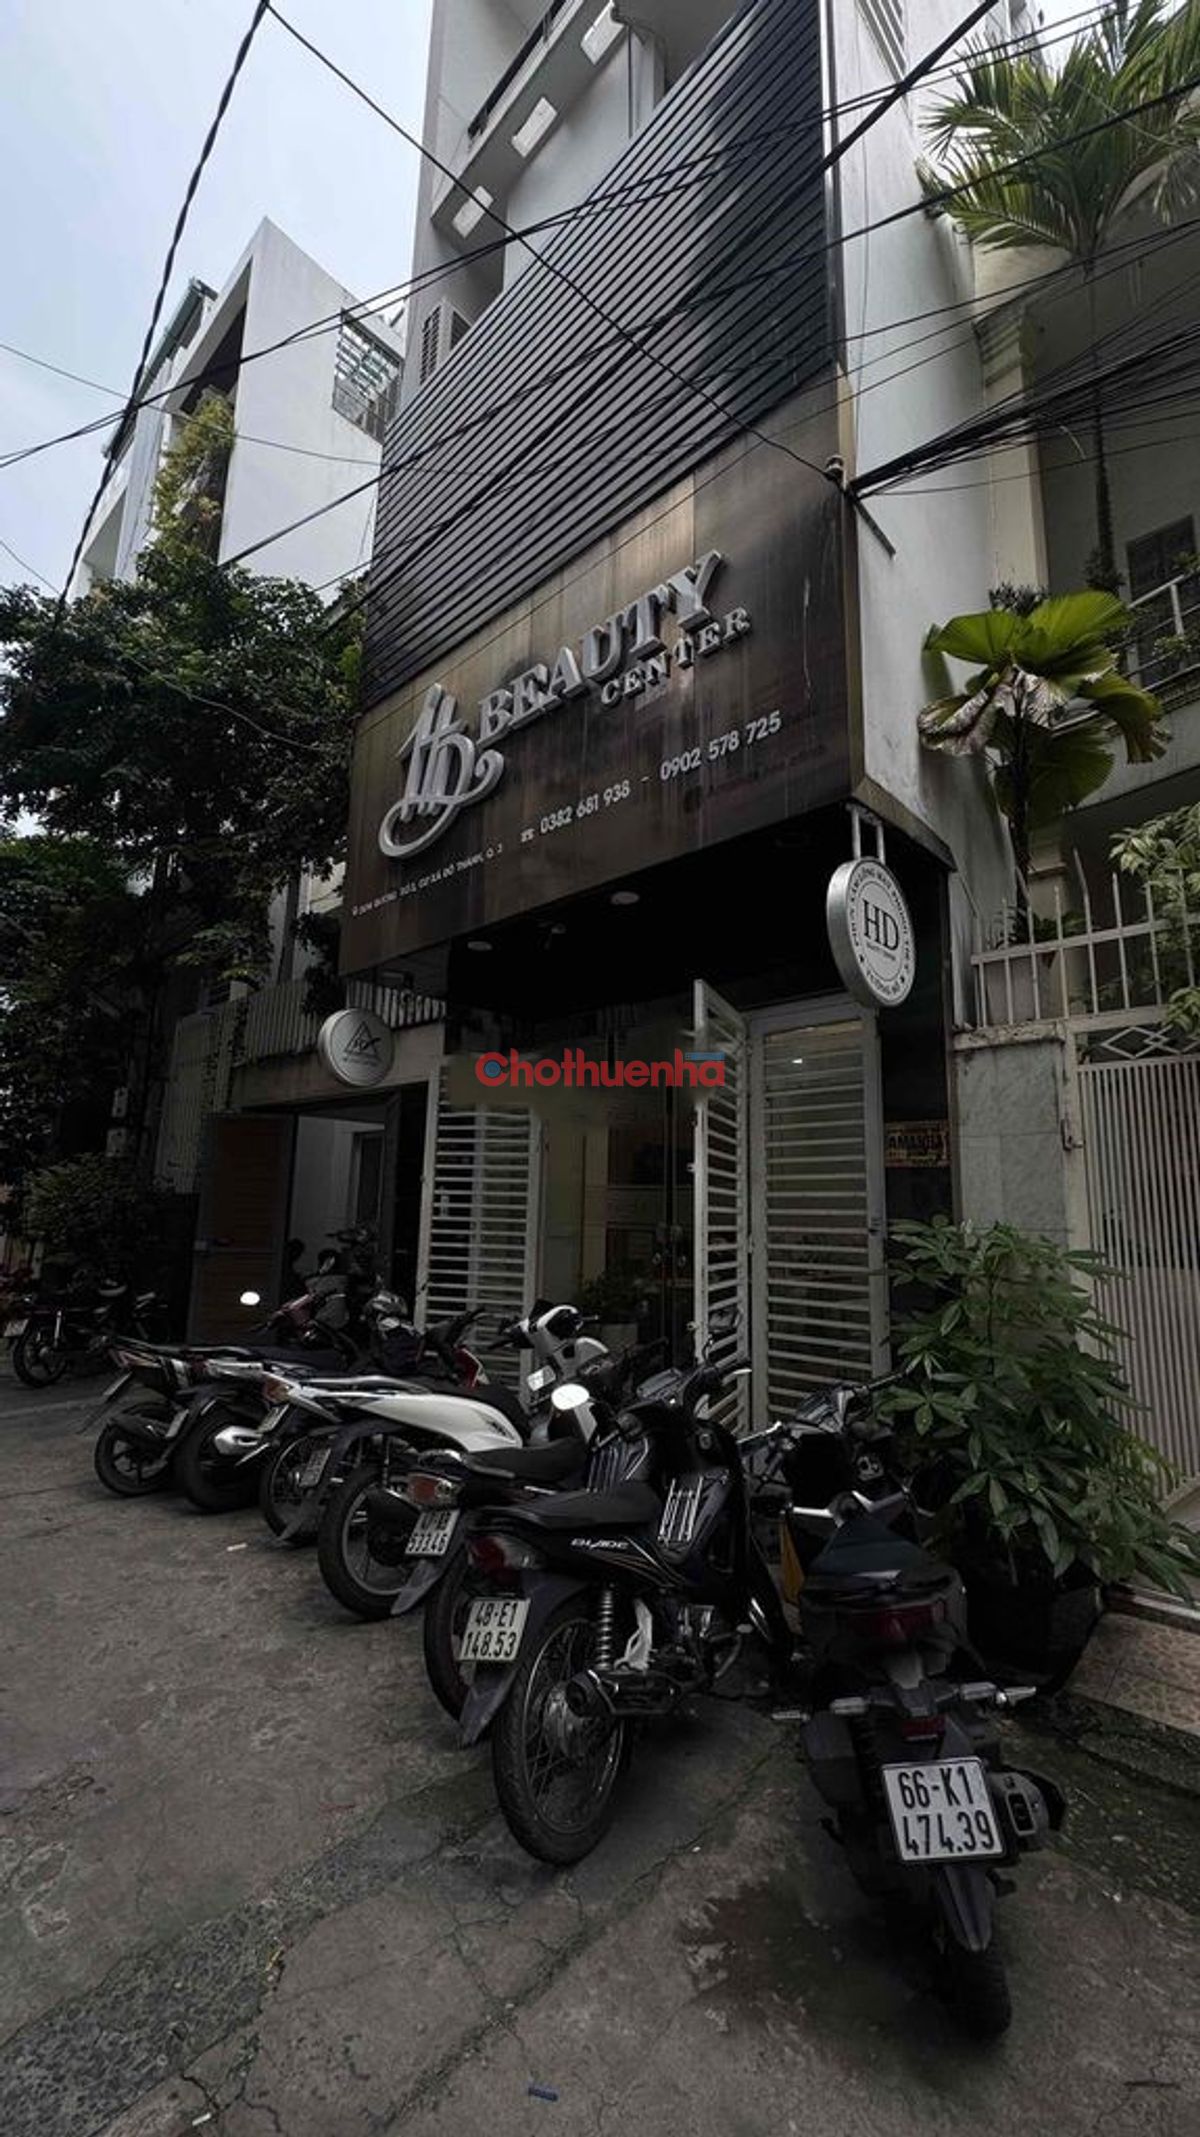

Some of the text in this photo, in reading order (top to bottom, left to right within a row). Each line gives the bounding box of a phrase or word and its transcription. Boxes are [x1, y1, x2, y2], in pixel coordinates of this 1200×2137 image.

[475, 549, 725, 746] BEAUTY
[601, 607, 751, 704] CENTER
[540, 805, 573, 834] 0382
[576, 793, 599, 818] 681
[603, 780, 631, 807] 938
[660, 747, 701, 781] 0902
[709, 730, 739, 760] 578
[746, 710, 782, 744] 725
[863, 898, 899, 951] HD
[464, 1630, 517, 1657] 148.53
[898, 1766, 974, 1809] 66-K1
[903, 1809, 995, 1856] 474.39
